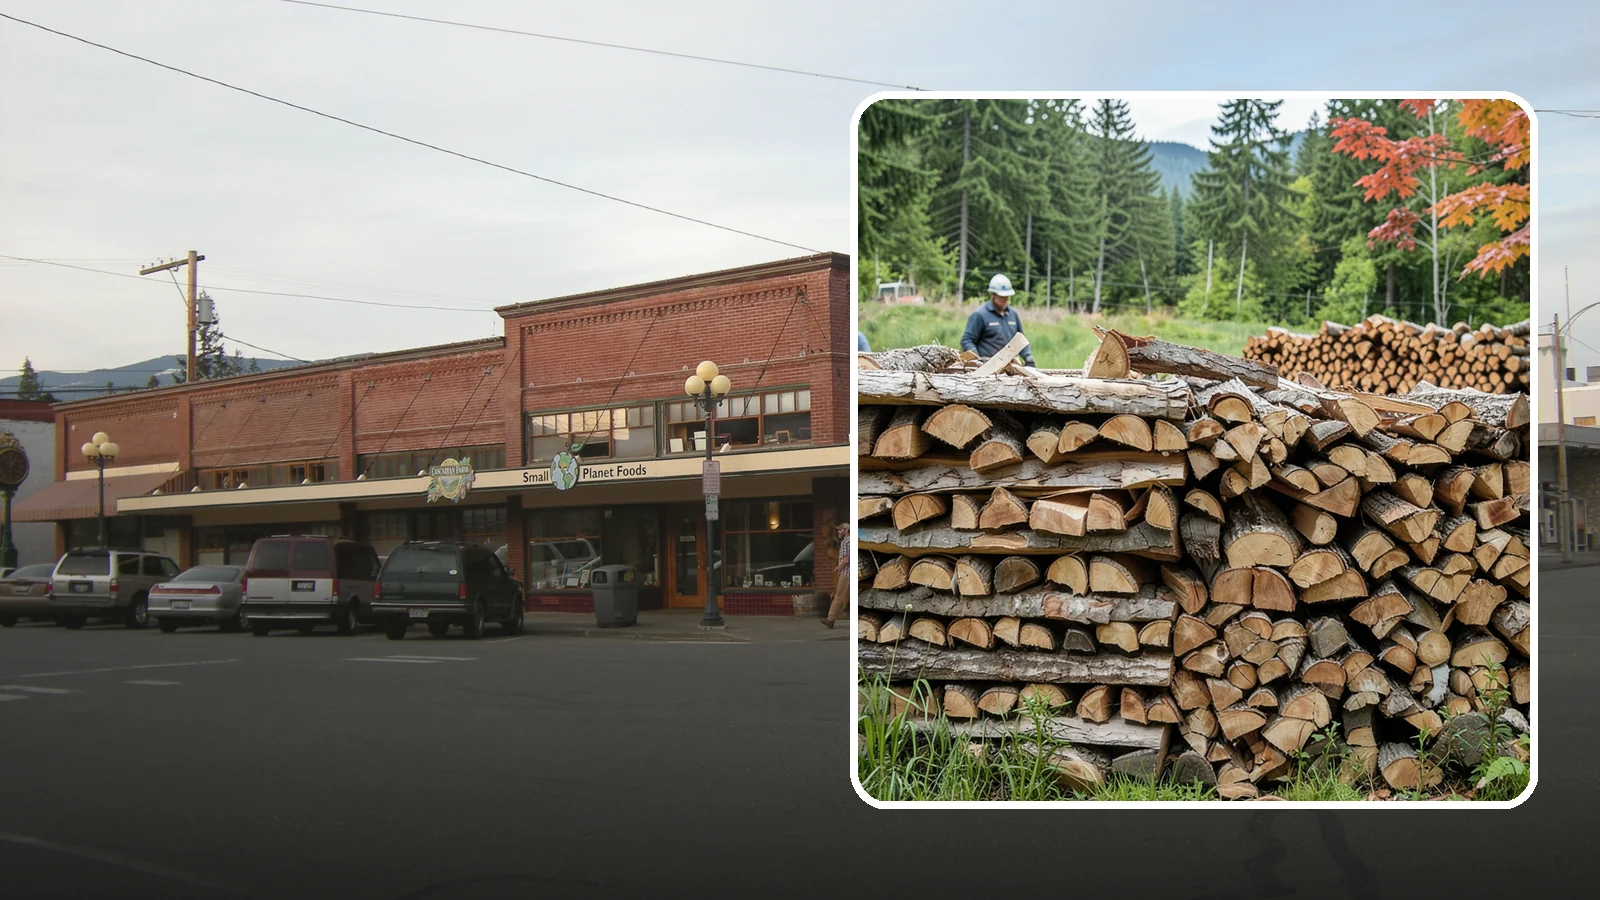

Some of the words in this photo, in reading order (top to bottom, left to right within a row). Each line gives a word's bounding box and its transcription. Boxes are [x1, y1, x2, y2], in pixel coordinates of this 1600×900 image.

[456, 465, 469, 474] FARM
[523, 471, 549, 483] Small
[582, 467, 614, 480] Planet
[617, 464, 647, 477] Foods
